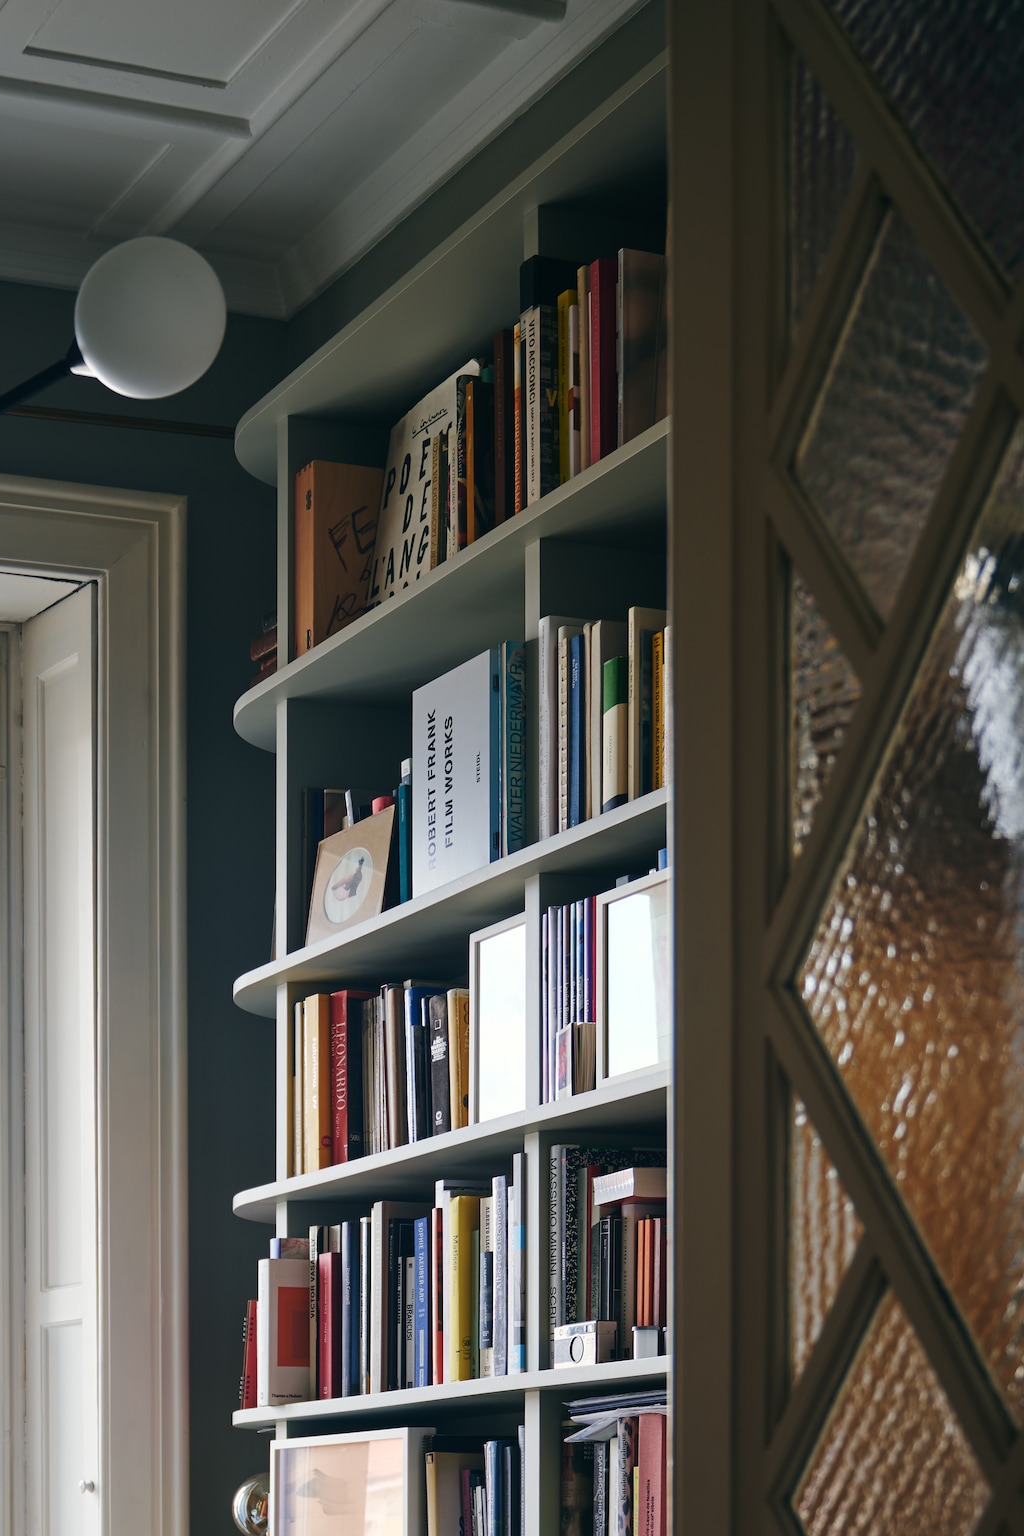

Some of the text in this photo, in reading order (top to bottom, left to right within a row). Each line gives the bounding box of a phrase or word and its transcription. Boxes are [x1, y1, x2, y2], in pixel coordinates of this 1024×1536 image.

[402, 480, 431, 534] DE
[427, 709, 437, 872] ROBERT FRANK
[444, 715, 454, 849] FILM WORKS
[508, 663, 524, 842] WALTER NIEDERMAYR
[335, 1021, 347, 1111] LEONARDO
